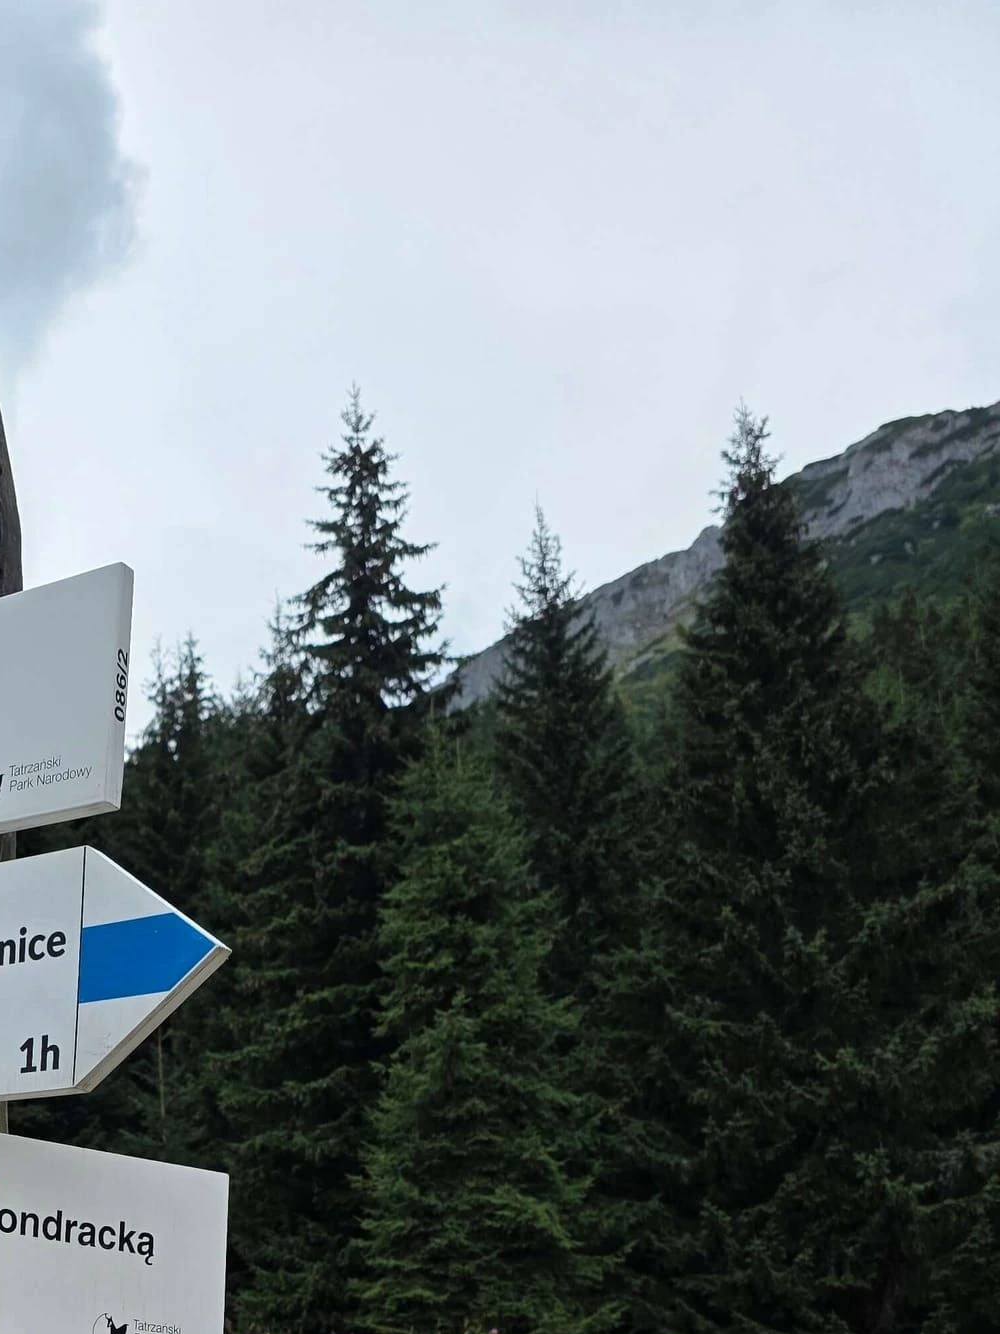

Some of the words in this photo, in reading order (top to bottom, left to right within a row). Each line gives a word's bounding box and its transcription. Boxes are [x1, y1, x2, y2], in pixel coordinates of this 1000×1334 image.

[114, 648, 129, 723] 086/2
[9, 754, 62, 776] Tatrzański
[9, 776, 34, 793] Park
[36, 764, 93, 788] Narodowy
[19, 1034, 60, 1074] 1h
